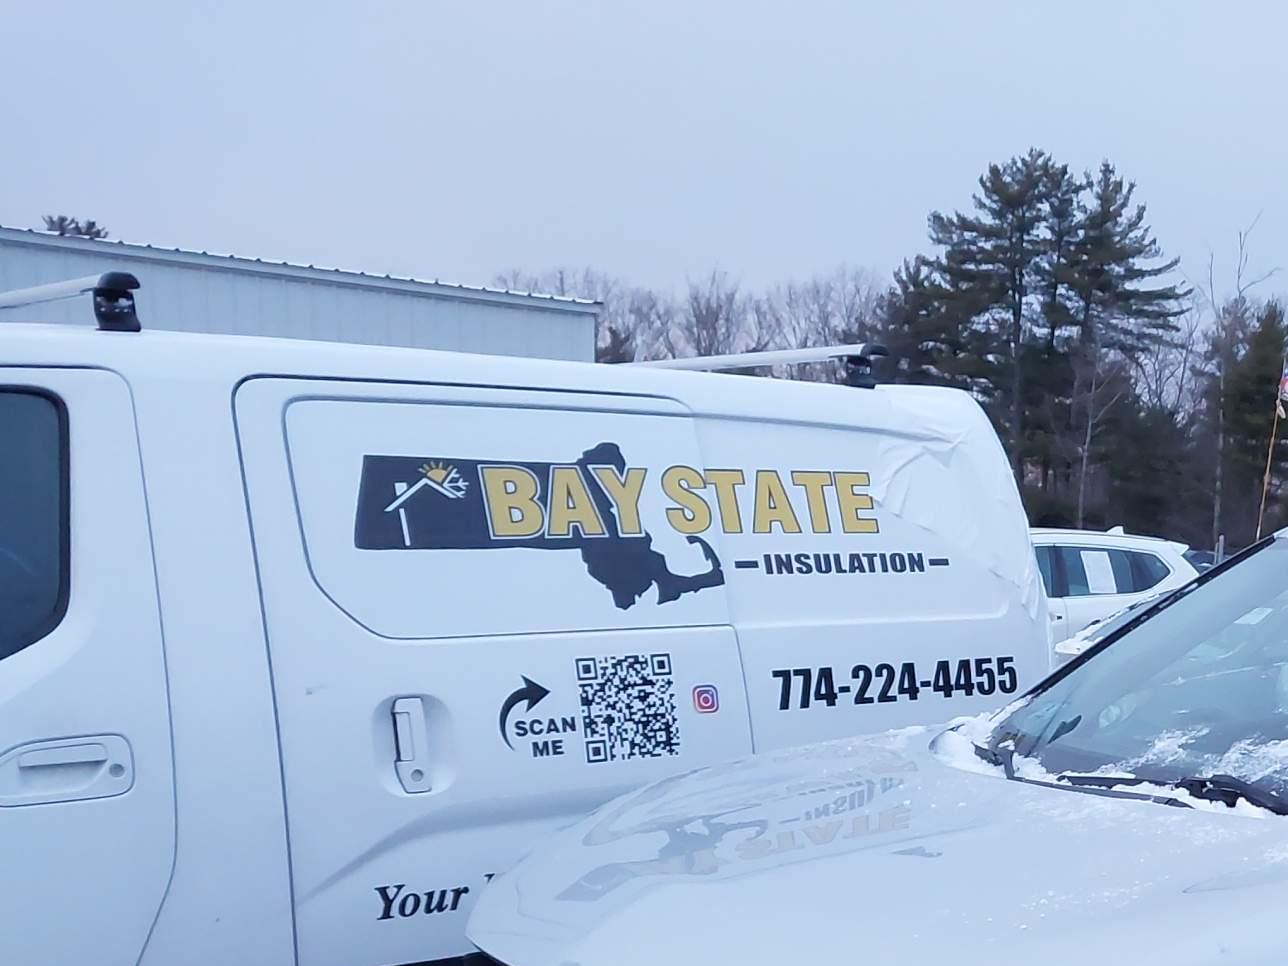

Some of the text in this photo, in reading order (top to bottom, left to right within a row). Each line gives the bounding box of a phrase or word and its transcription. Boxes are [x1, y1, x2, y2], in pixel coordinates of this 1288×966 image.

[477, 464, 879, 539] BAY STATE
[763, 551, 926, 577] INSULATION
[772, 656, 1018, 711] 774-224-4455
[513, 715, 576, 739] SCAN
[532, 739, 566, 758] ME
[374, 884, 470, 921] Your
